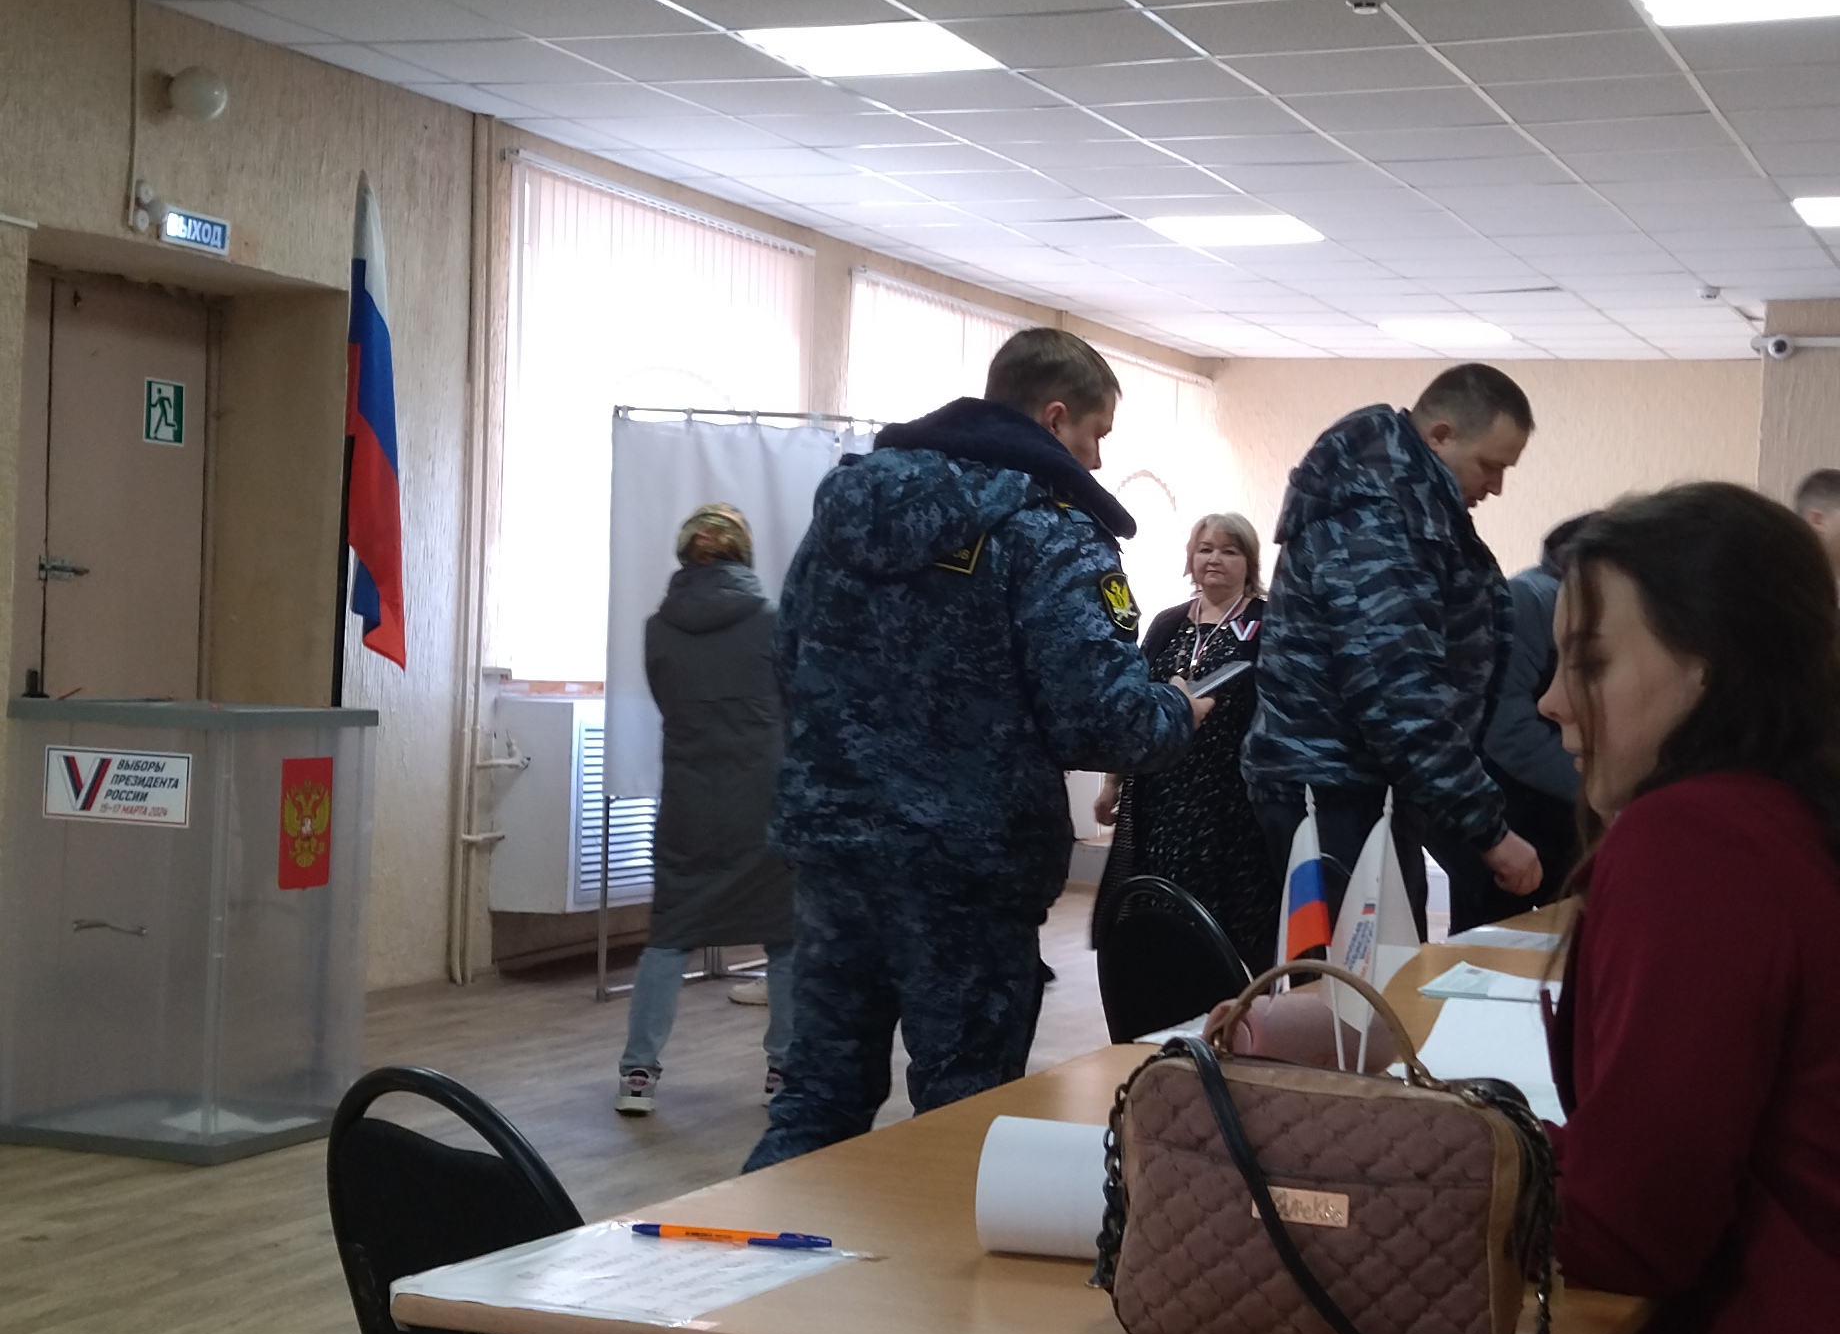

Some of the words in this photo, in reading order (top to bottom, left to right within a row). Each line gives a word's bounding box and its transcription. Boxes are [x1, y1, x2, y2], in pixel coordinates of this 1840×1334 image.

[117, 759, 166, 773] ВЫБОРЫ
[110, 774, 179, 789] ПРЕЗИДЕНТА
[104, 789, 148, 802] РОССИИ
[119, 805, 148, 816] МАРТА
[148, 807, 168, 817] 2024
